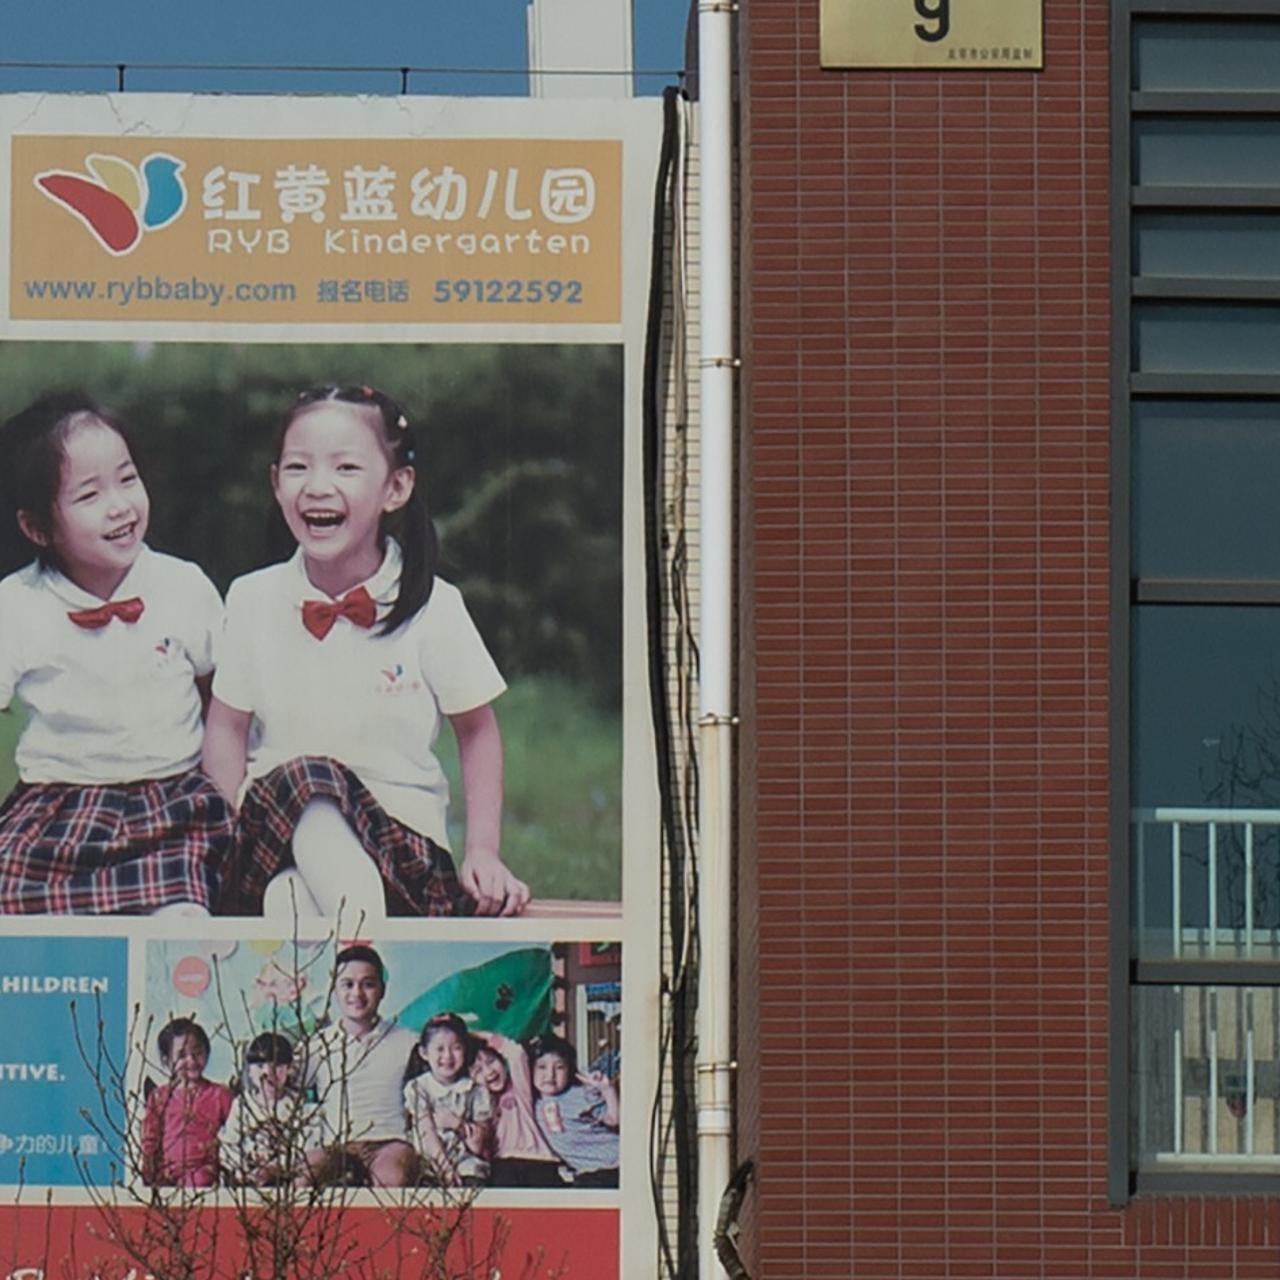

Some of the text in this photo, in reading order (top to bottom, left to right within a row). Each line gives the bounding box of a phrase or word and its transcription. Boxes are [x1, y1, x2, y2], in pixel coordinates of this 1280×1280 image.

[203, 166, 595, 223] 红黄蓝幼儿园
[208, 228, 590, 255] RYB Kindergarten
[25, 276, 583, 306] www.rybbaby.com 报名电话 59122592
